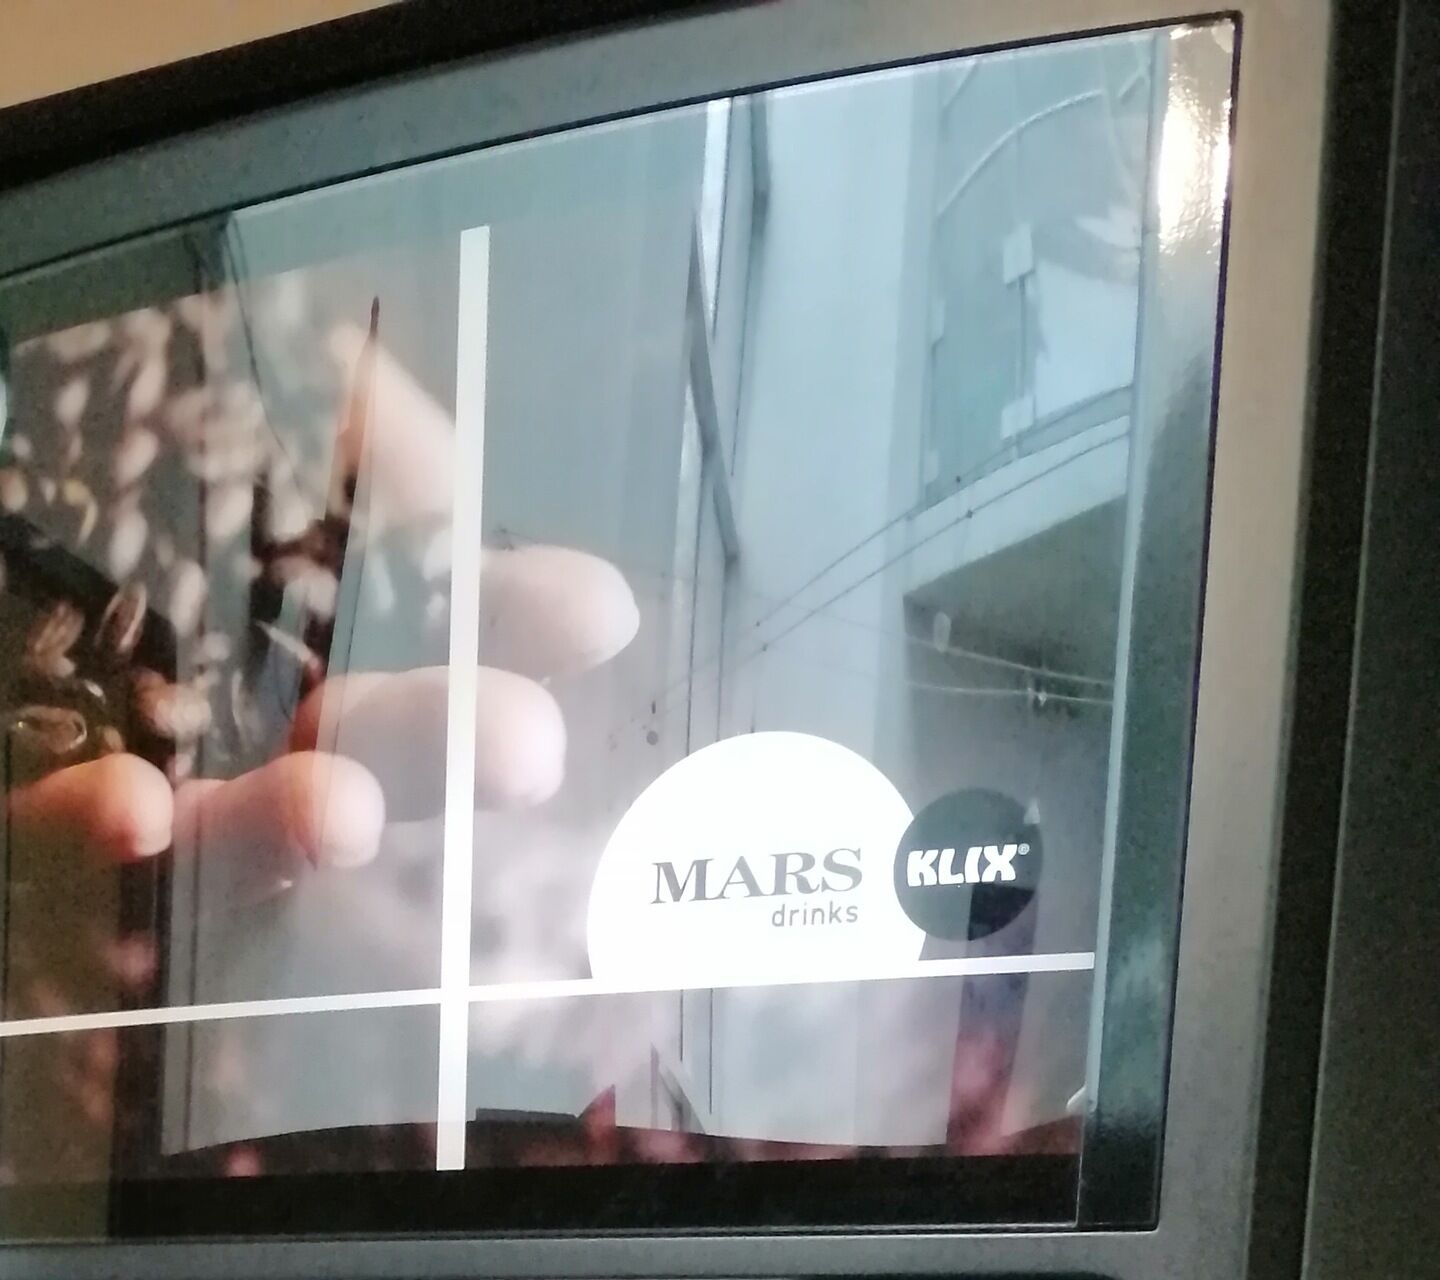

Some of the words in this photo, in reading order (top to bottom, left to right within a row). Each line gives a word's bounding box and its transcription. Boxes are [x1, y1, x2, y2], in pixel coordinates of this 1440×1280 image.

[651, 847, 862, 904] MARS
[906, 843, 1018, 887] KLIX
[772, 900, 858, 927] drinks
